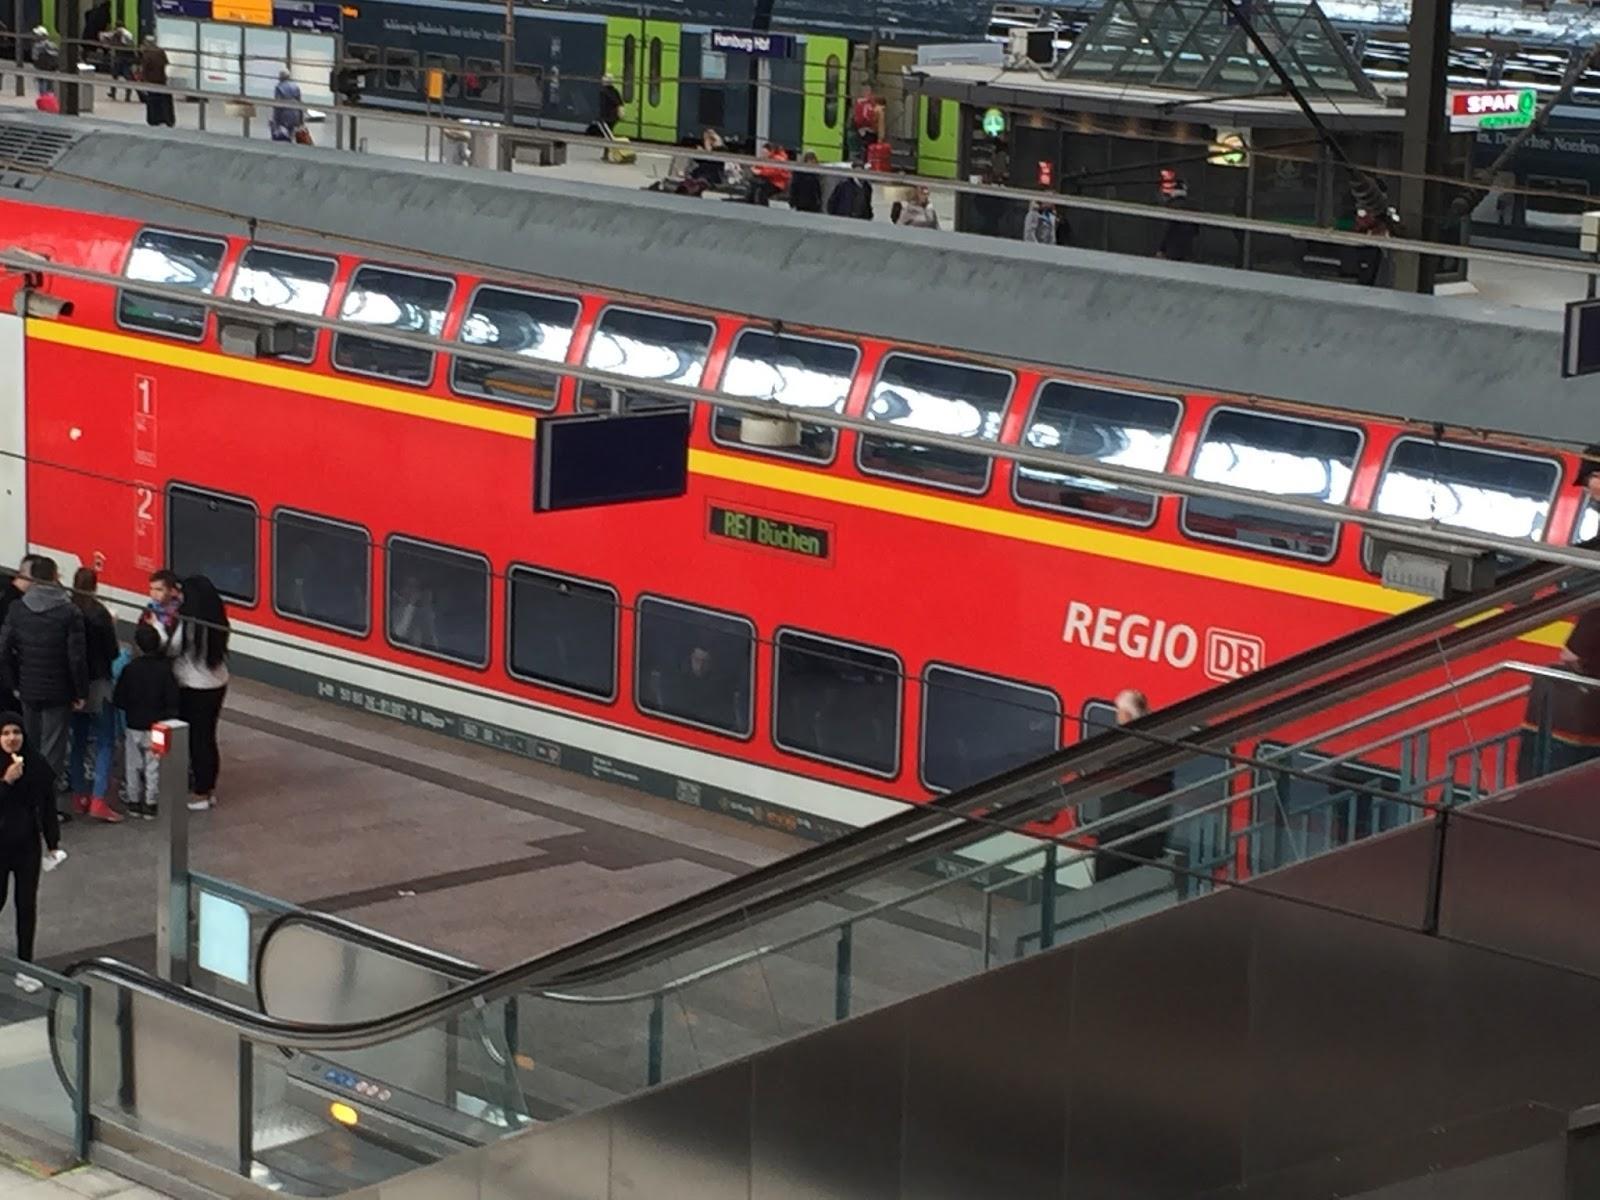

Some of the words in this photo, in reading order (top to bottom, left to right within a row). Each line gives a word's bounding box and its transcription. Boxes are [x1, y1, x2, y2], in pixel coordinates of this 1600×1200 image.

[713, 32, 753, 52] Hamburg
[1467, 94, 1520, 113] SPAR
[138, 378, 150, 414] 1
[137, 487, 153, 520] 2
[724, 510, 752, 540] RE1
[757, 518, 821, 556] Büchen
[1062, 600, 1199, 669] REGIO
[1211, 636, 1260, 678] DB
